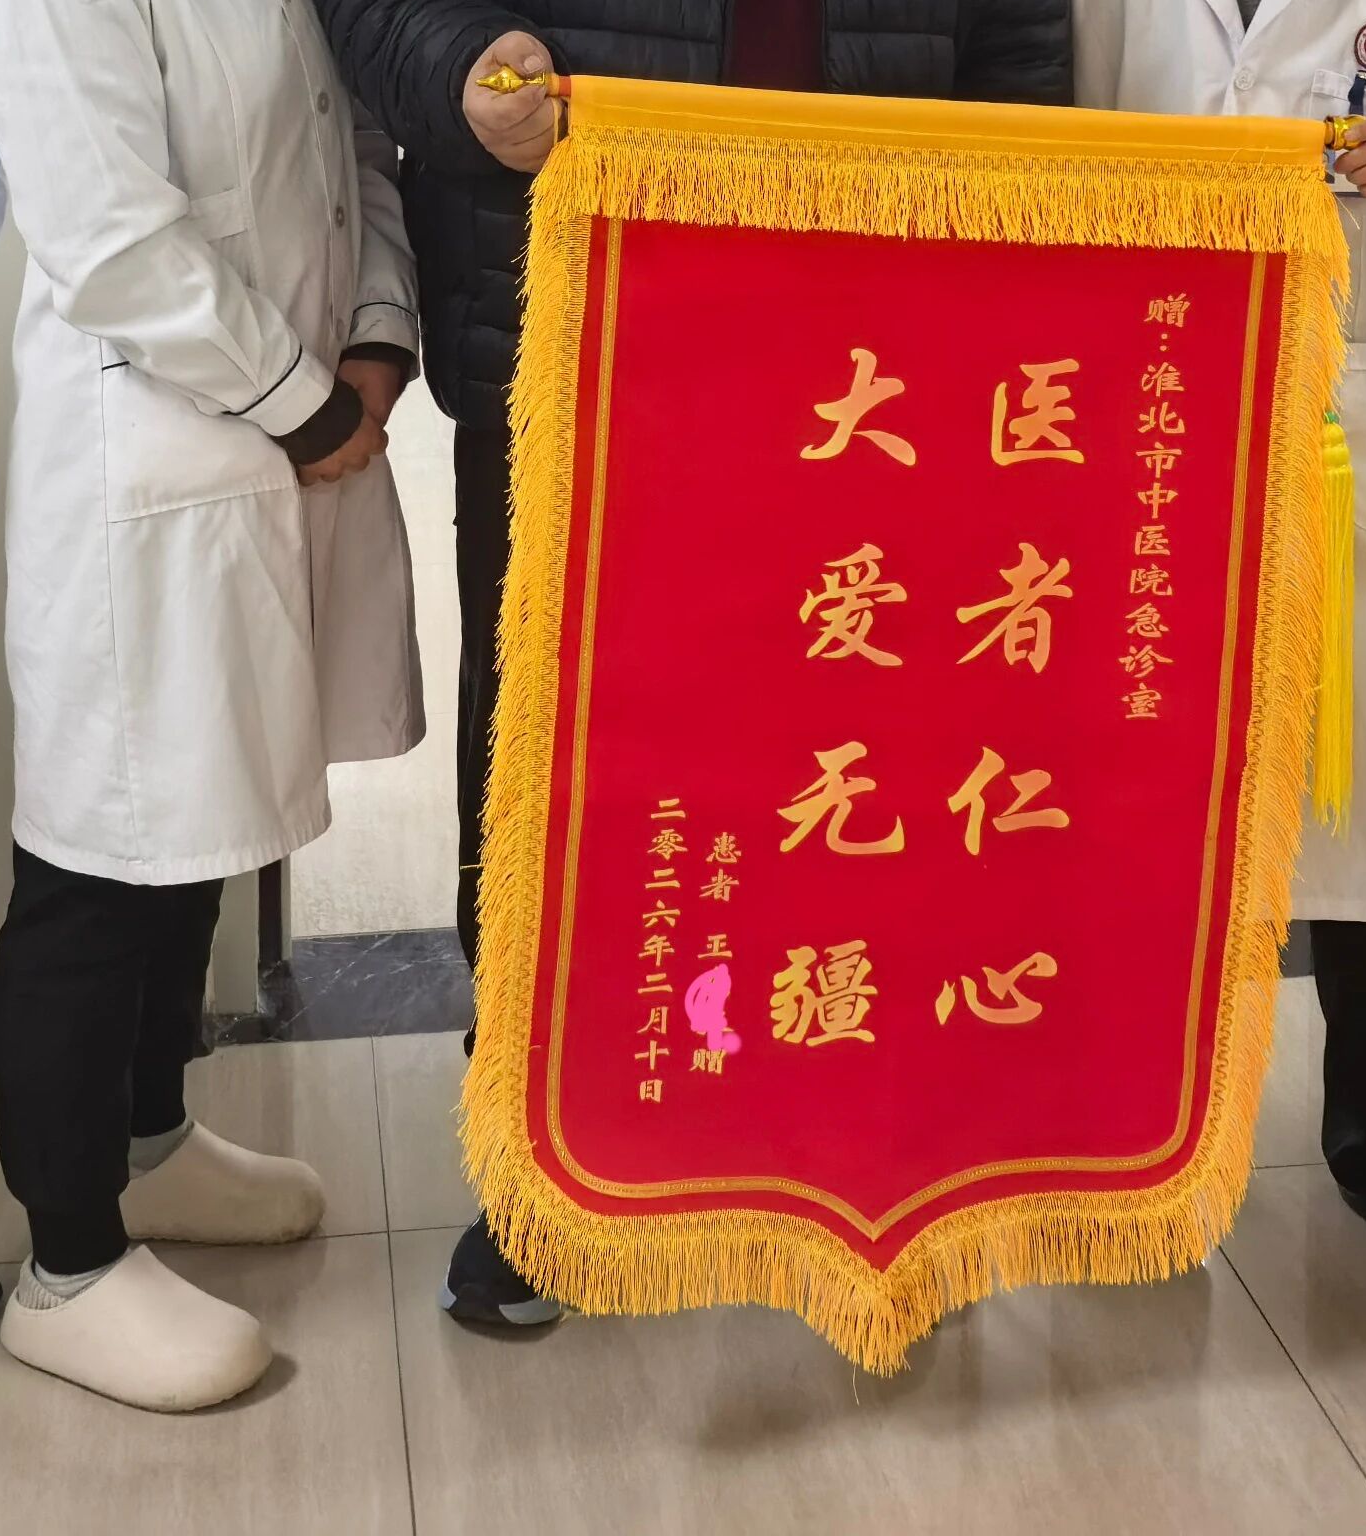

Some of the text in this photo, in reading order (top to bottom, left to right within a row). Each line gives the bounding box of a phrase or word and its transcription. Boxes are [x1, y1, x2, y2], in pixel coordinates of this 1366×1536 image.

[769, 348, 917, 1047] 大爱无疆
[935, 358, 1085, 1025] 医者仁心
[1118, 294, 1191, 720] 赠：淮北市中医院急诊室
[634, 798, 688, 1103] 二零二六年二月十日
[700, 832, 742, 902] 患者
